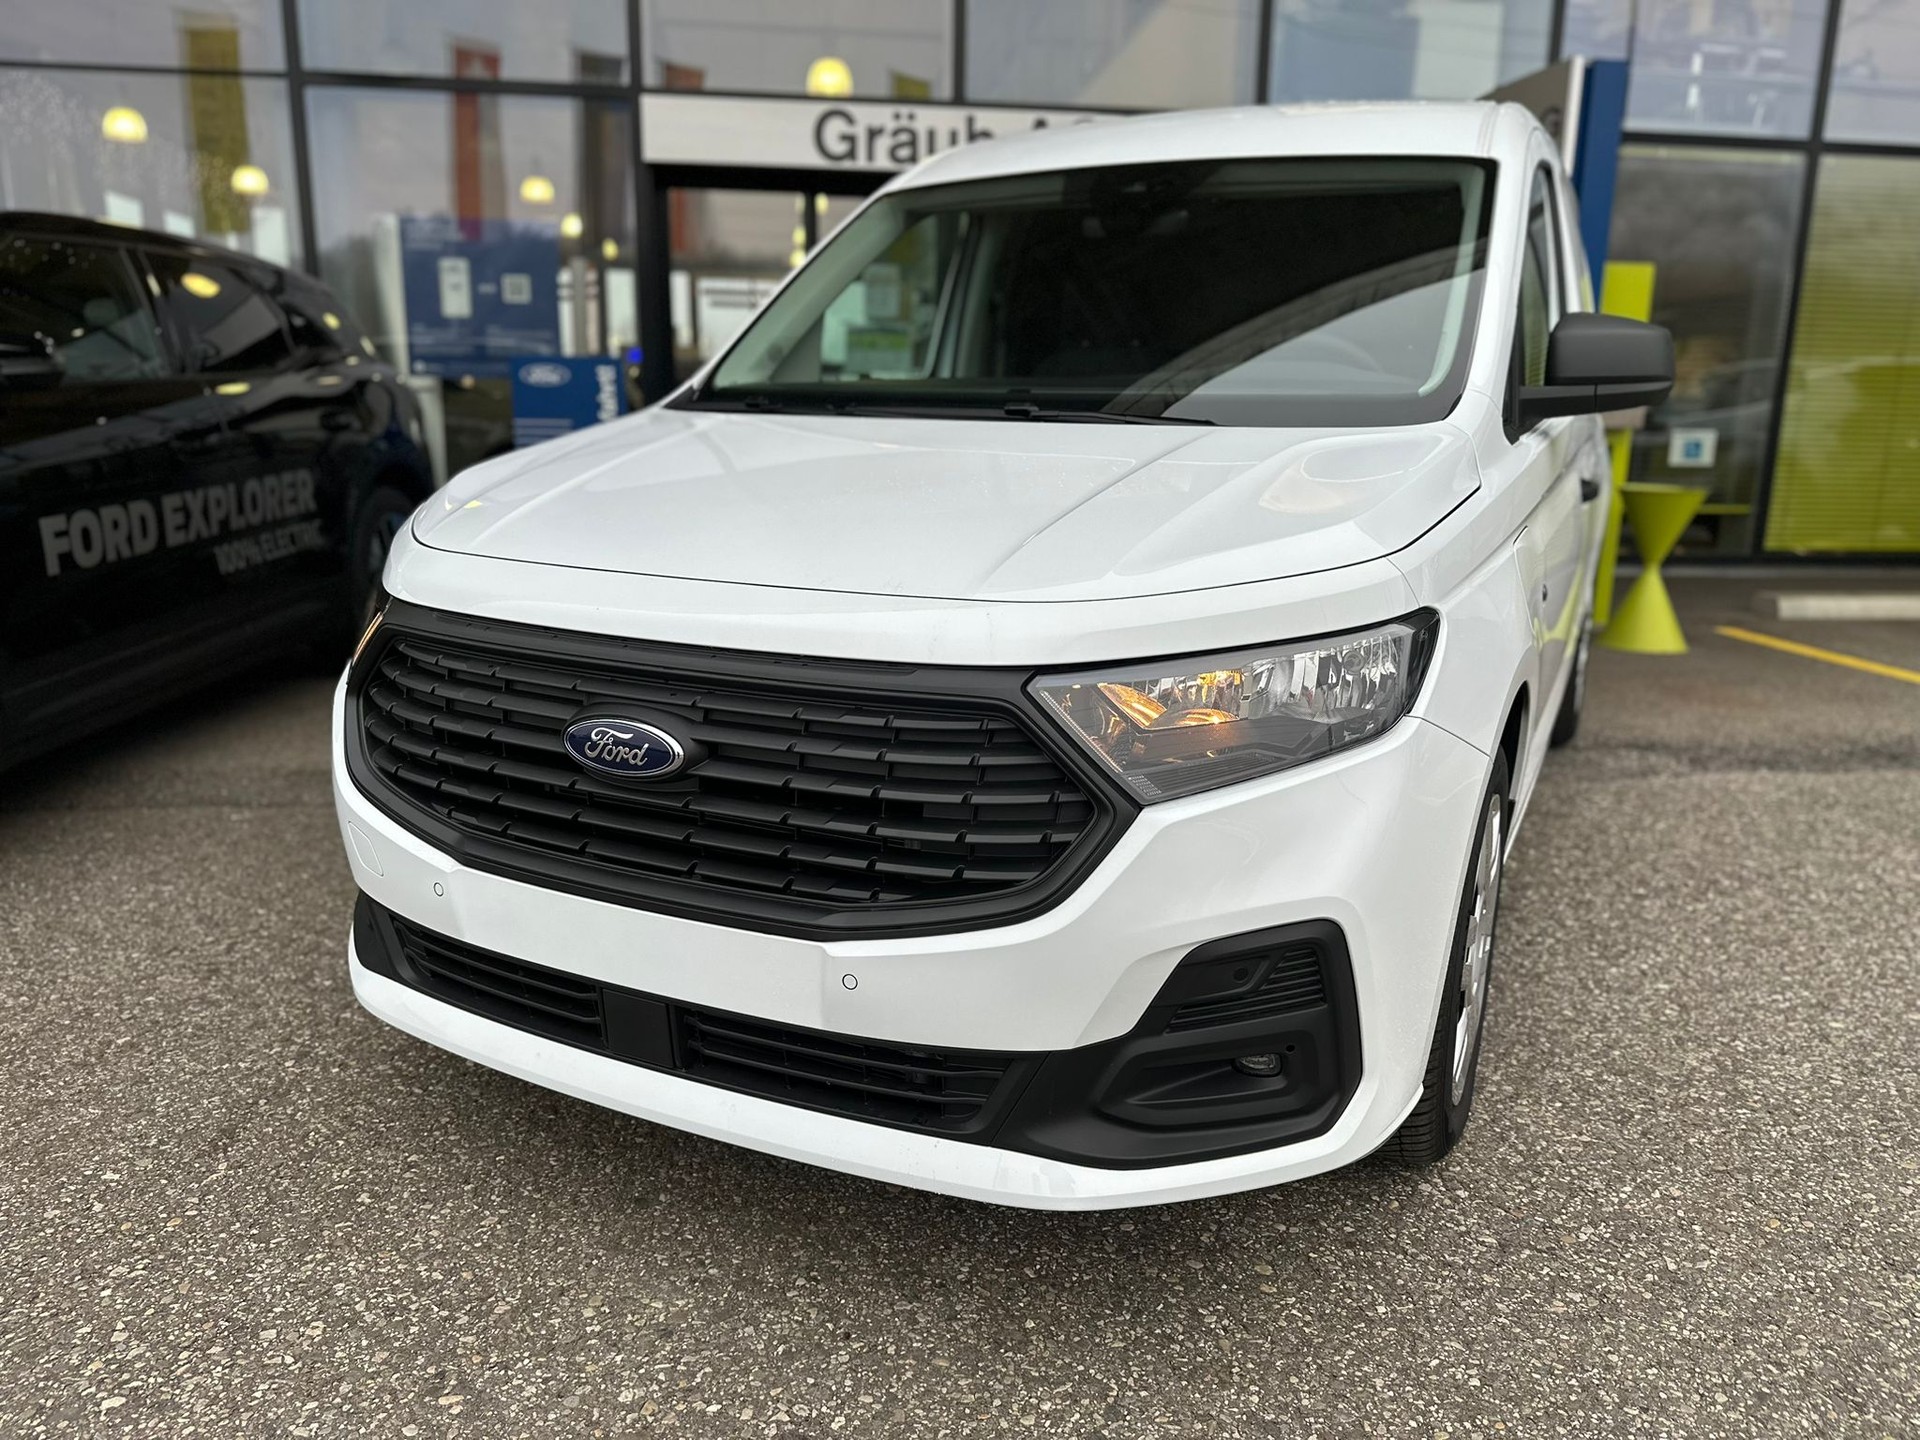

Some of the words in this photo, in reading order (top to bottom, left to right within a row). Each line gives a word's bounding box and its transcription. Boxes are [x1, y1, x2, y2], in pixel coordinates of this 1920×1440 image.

[38, 498, 159, 578] FORD
[161, 468, 318, 548] EXPLORER
[213, 537, 263, 575] 100%
[257, 519, 326, 560] ELECTRIC
[584, 727, 650, 766] Ford
